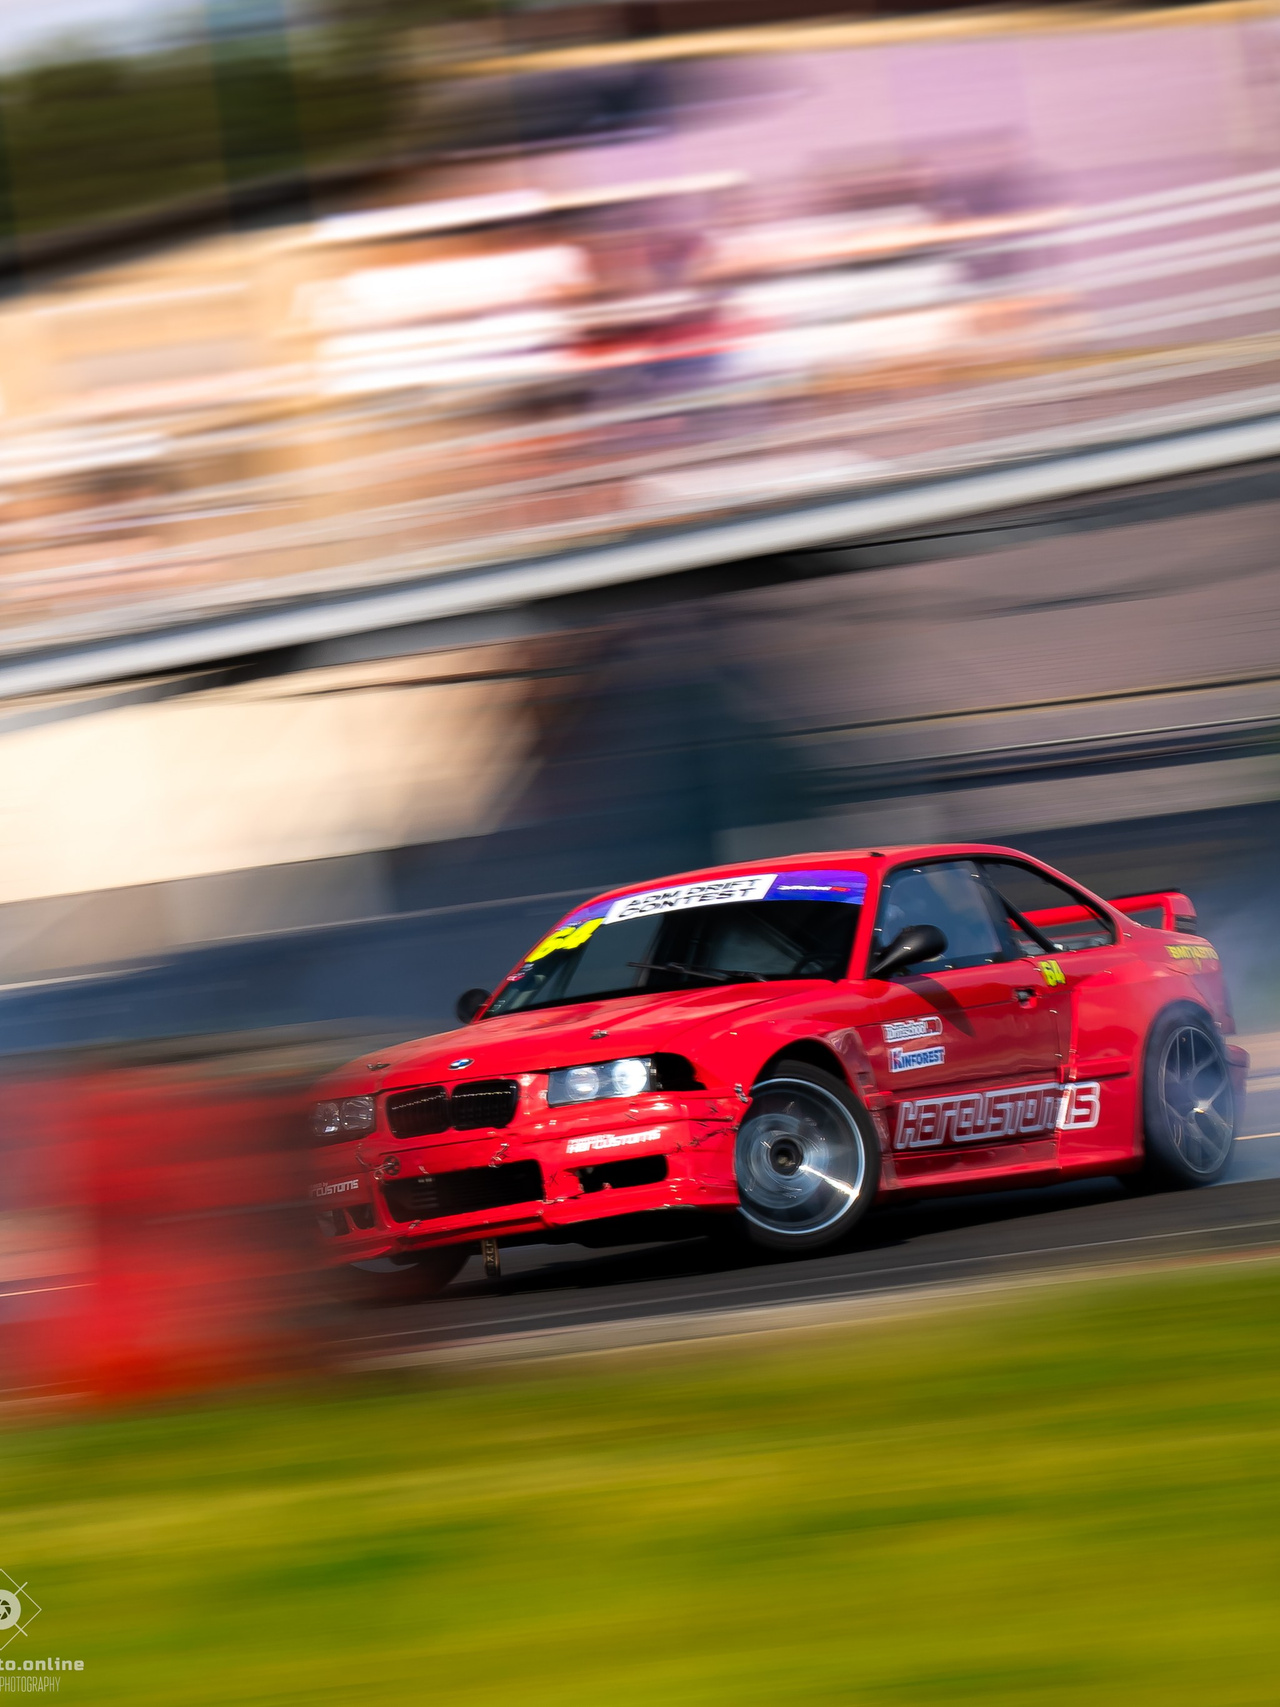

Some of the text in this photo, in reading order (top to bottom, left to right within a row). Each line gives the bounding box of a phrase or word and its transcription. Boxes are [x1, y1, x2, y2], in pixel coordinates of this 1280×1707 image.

[618, 887, 757, 918] CONTEST
[626, 889, 683, 907] ADM
[686, 878, 762, 896] DRIFT
[1037, 959, 1066, 987] 64
[892, 1049, 945, 1070] KINFOREST
